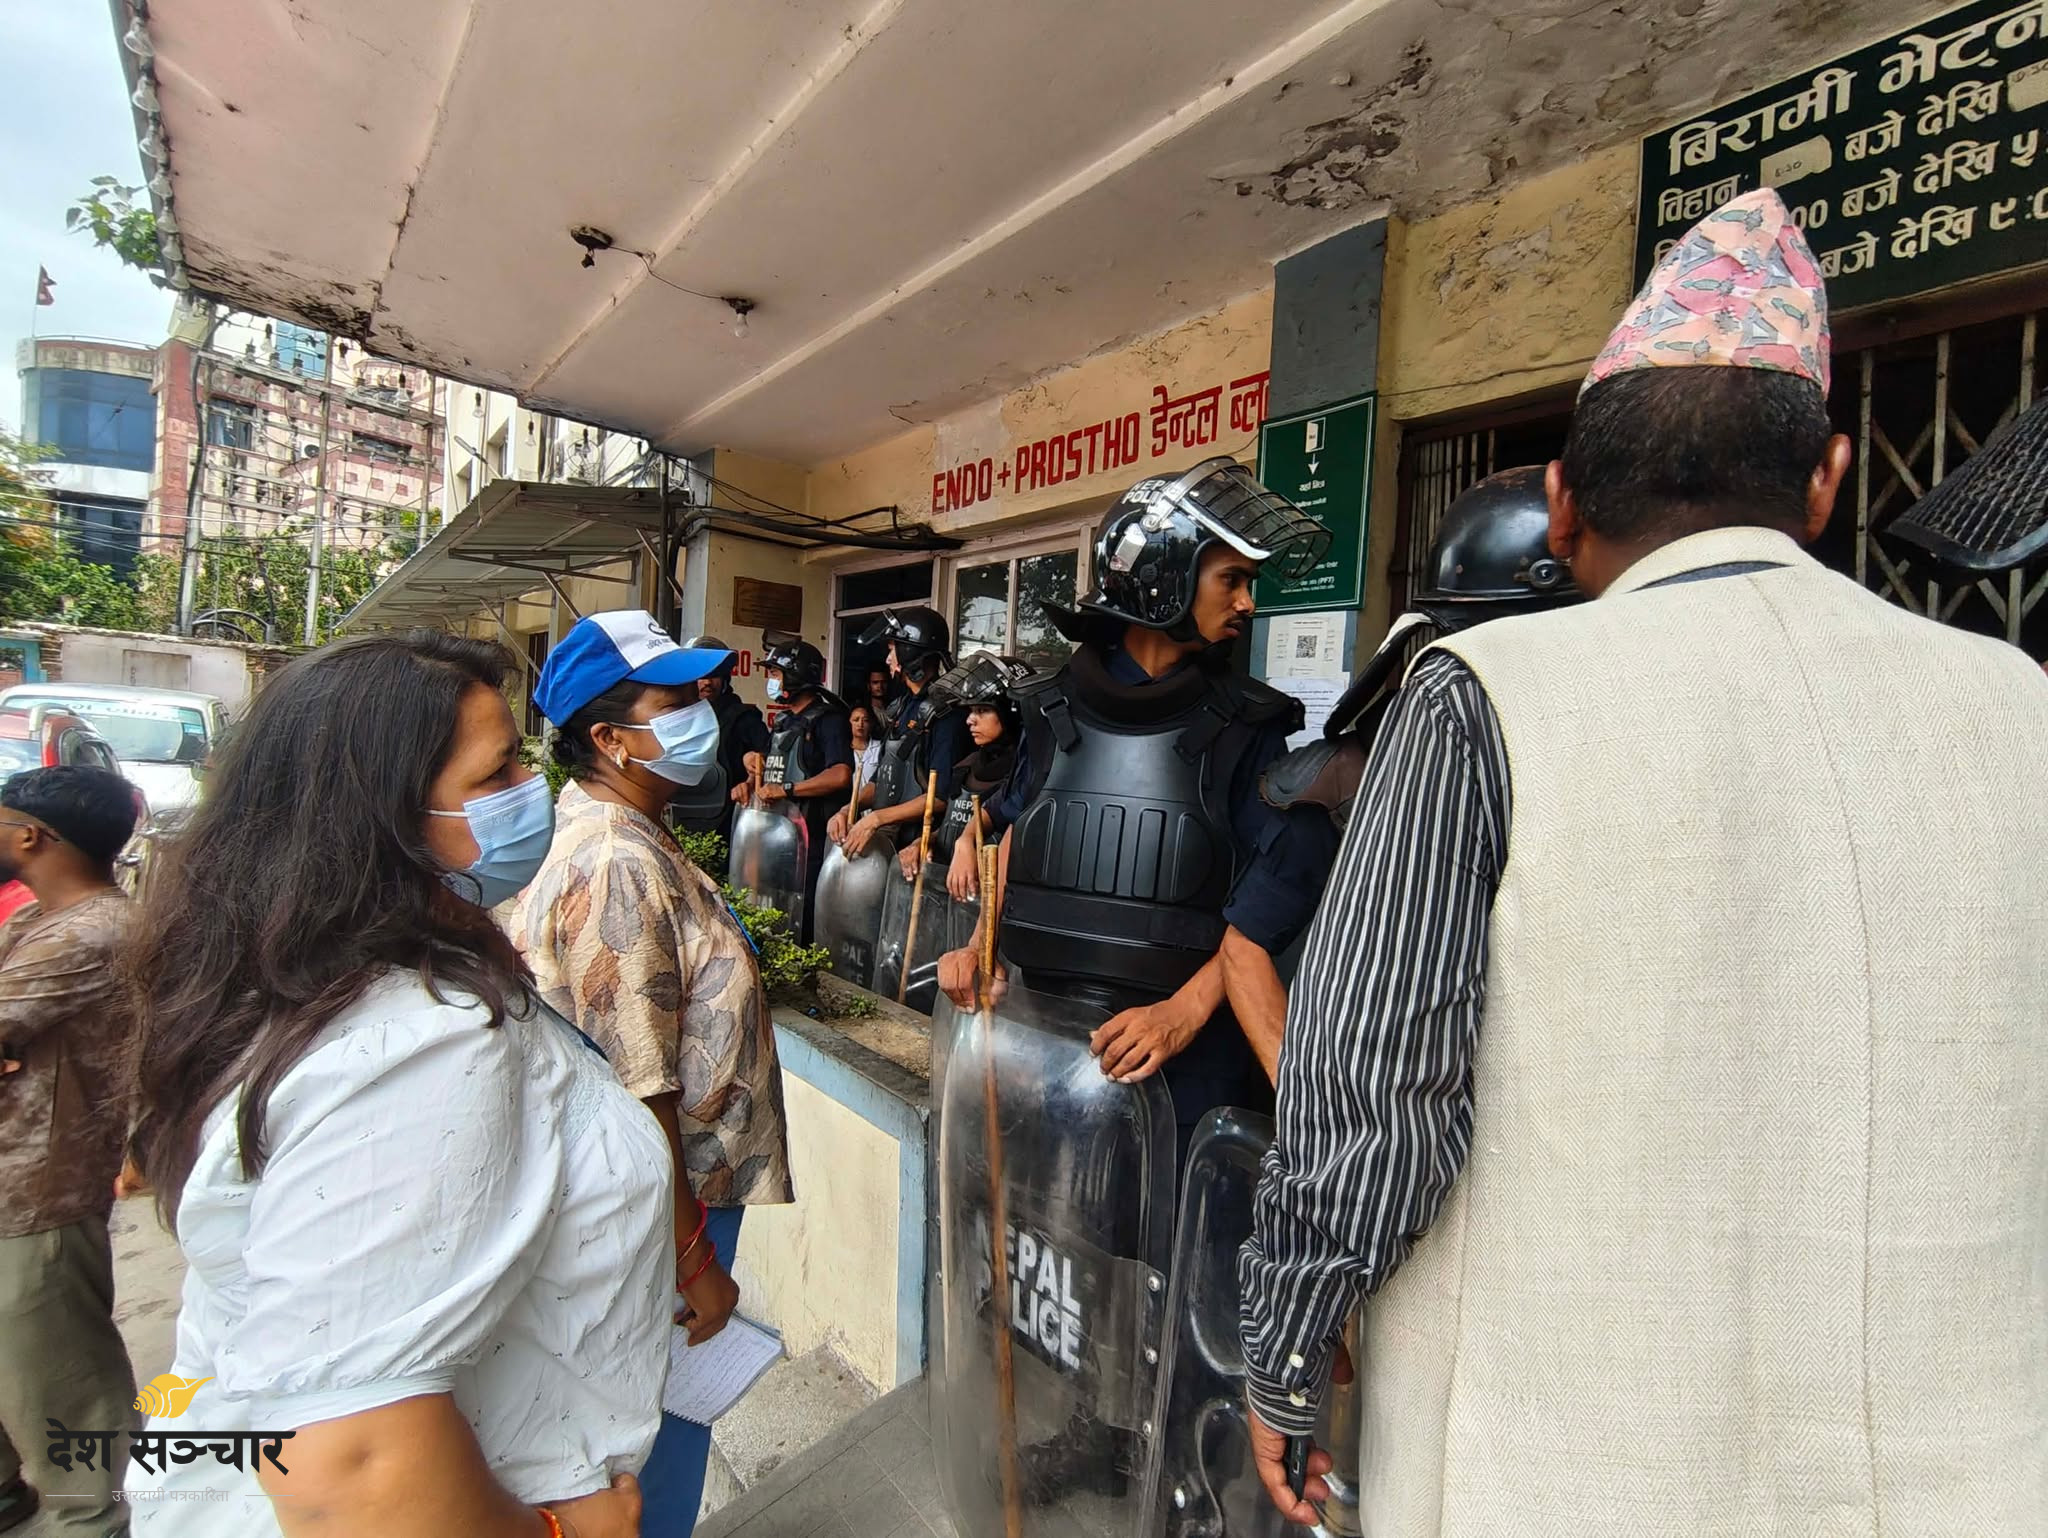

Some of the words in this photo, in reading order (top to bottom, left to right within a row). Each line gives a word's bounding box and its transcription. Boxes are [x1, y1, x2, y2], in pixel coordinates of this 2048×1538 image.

[1669, 67, 1858, 176] बिरामी
[1844, 110, 1906, 162] बजे
[1916, 80, 2004, 136] देखि
[1842, 167, 1902, 217] बजे
[1912, 140, 2000, 194] देखि
[1820, 230, 1880, 278] बजे
[1890, 205, 1978, 259] देखि
[1150, 385, 1223, 458] डेन्टल
[953, 799, 974, 811] NEP
